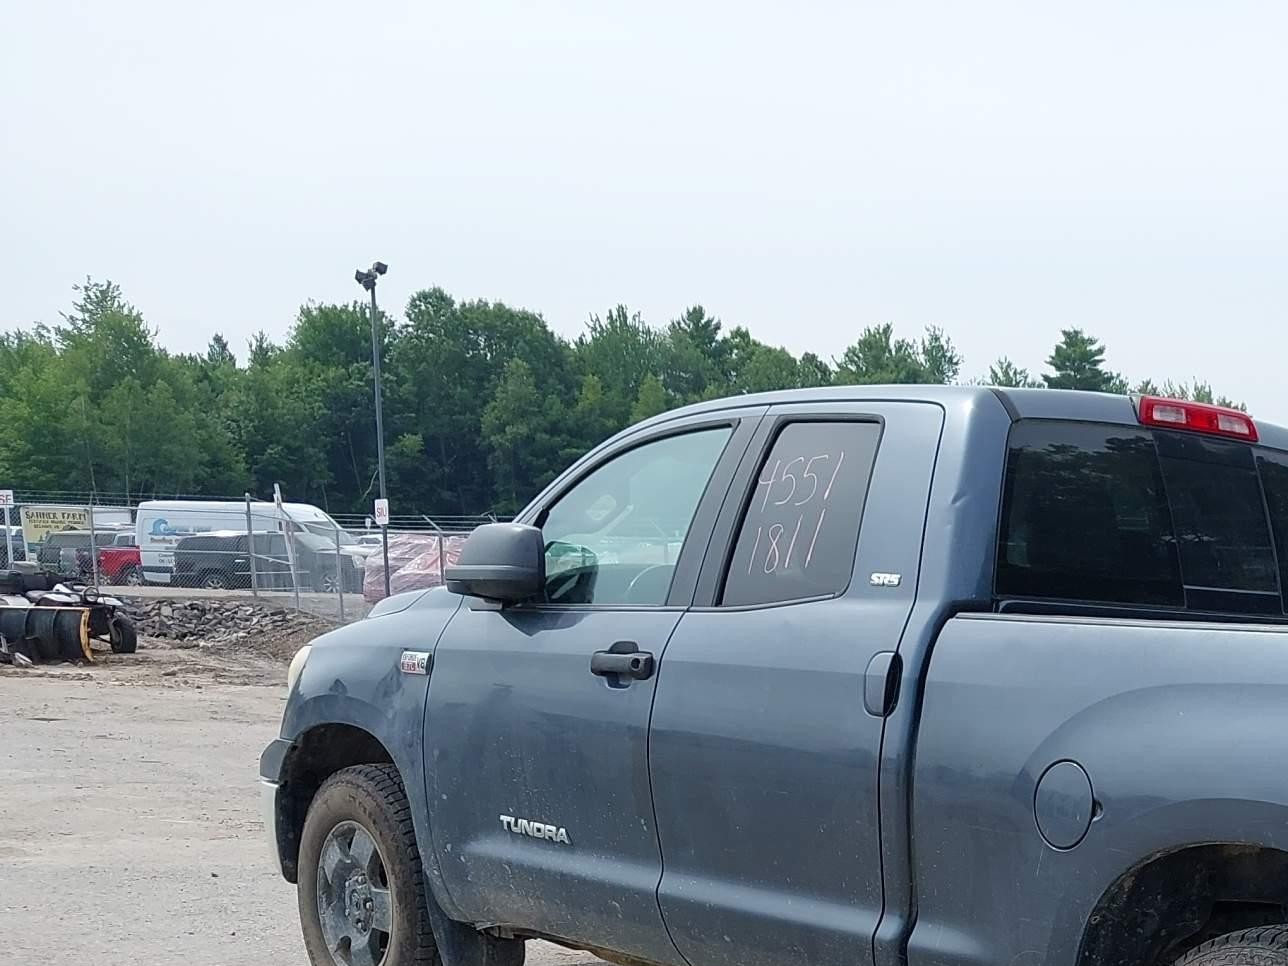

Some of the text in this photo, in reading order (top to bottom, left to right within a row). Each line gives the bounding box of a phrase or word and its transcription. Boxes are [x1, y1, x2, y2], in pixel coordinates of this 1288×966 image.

[758, 451, 845, 513] 4551
[747, 508, 826, 576] 1811
[869, 572, 902, 587] SR5
[499, 814, 570, 844] TUNDRA
